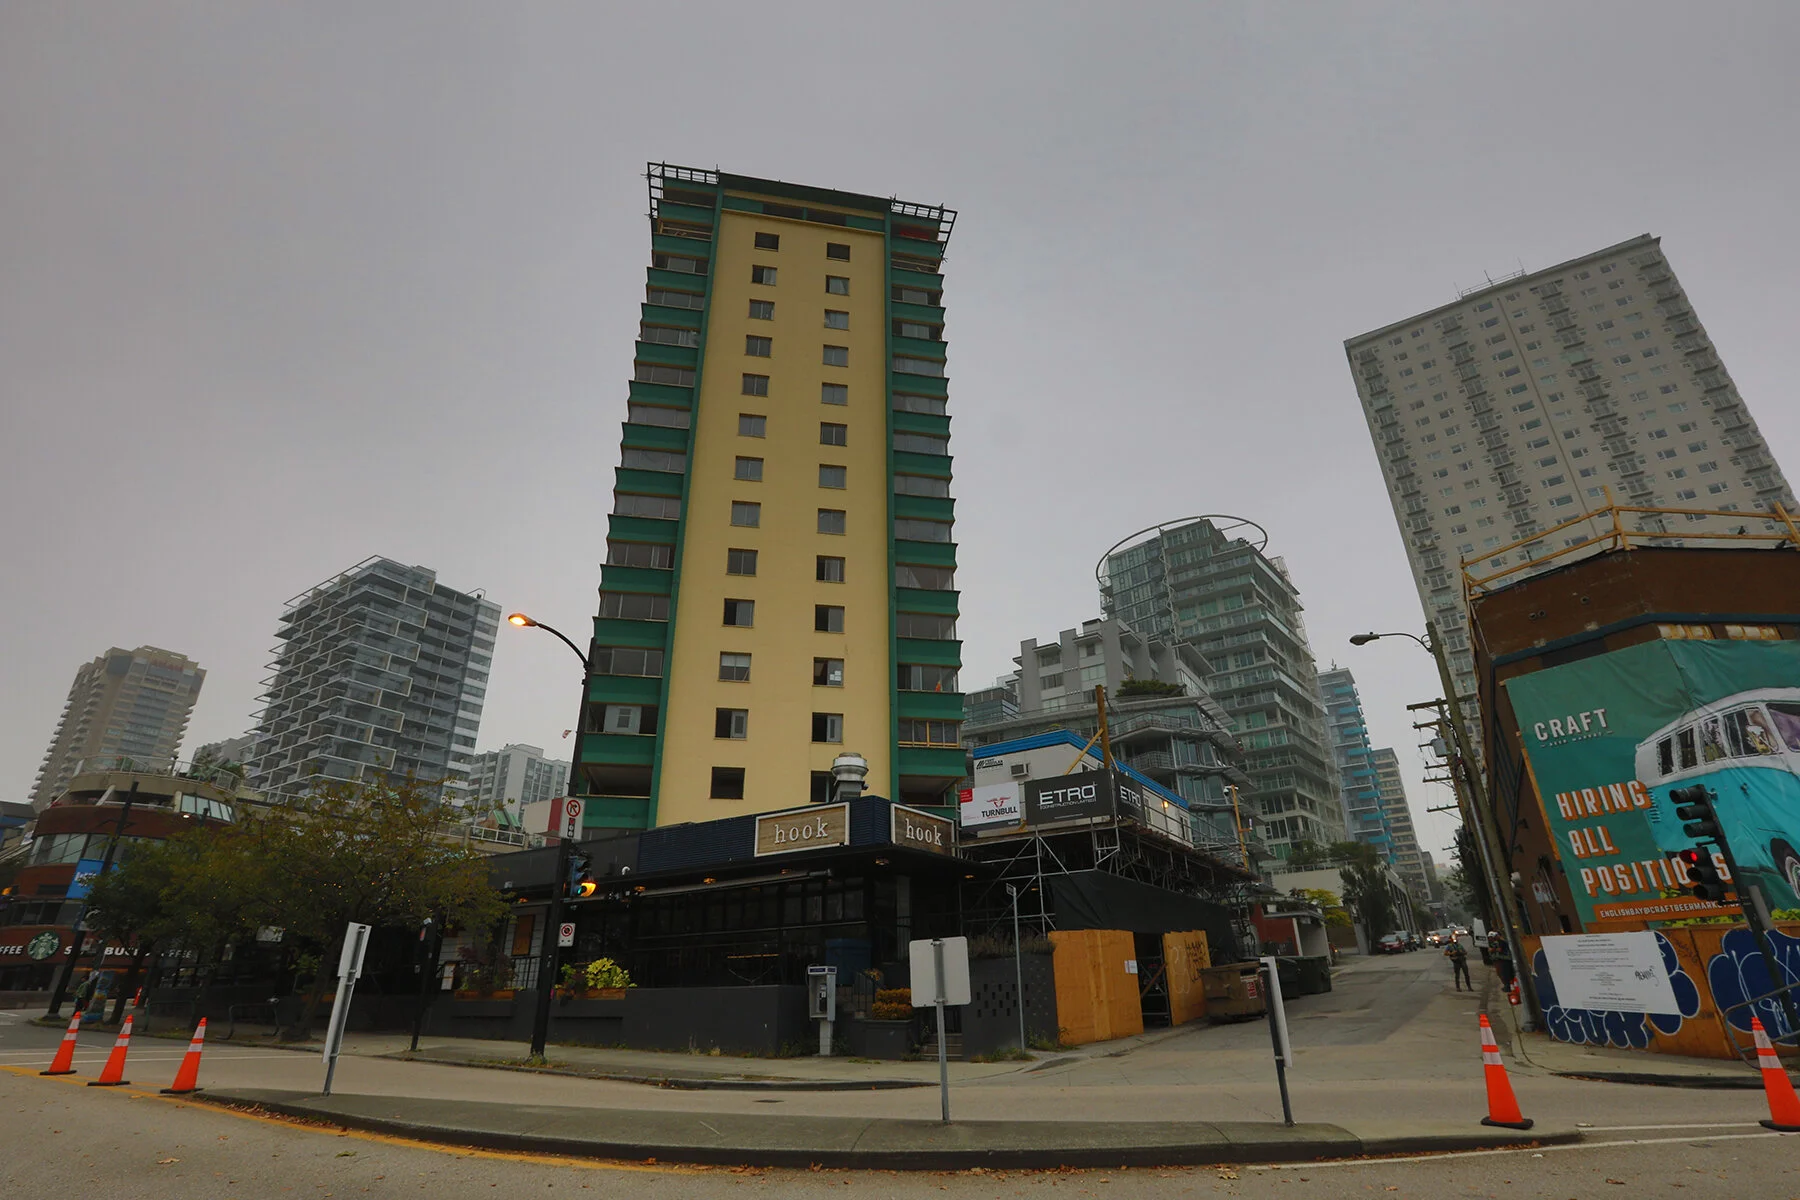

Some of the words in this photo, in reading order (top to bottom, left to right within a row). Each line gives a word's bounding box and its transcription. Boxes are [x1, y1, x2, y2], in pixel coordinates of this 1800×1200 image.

[1534, 708, 1608, 741] CRAFT
[1039, 784, 1096, 805] ETRO
[1119, 785, 1142, 807] ETRO
[1555, 780, 1650, 820] HIRING
[981, 806, 1018, 818] TURNBULL
[774, 817, 828, 844] hook
[905, 818, 943, 846] hook
[1568, 826, 1620, 858] ALL
[1580, 852, 1734, 897] POSITIOS
[1600, 899, 1740, 918] ENGLISHBAY@CRAFTBEERMARK
